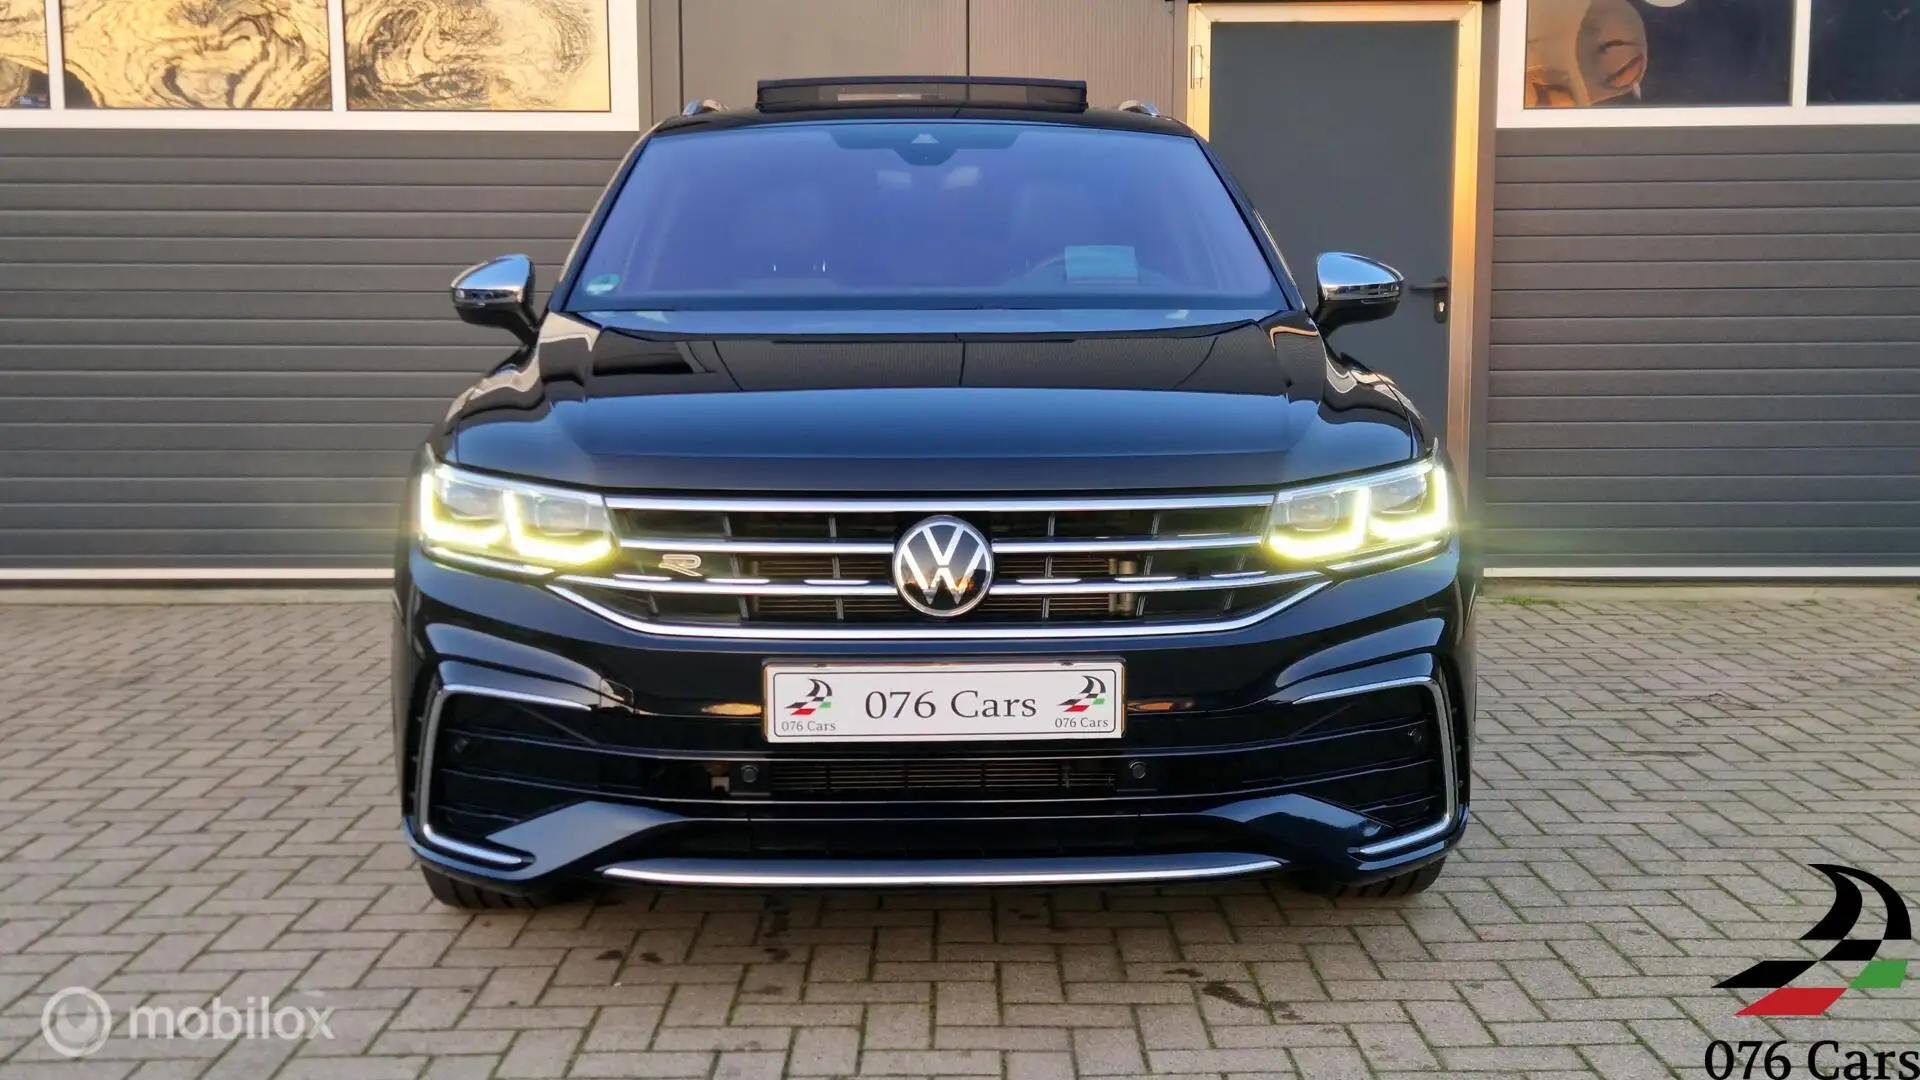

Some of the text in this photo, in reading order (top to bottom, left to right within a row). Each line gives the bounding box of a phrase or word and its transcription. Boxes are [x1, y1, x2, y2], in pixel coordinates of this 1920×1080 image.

[864, 689, 1038, 719] 076 Cars
[781, 720, 836, 731] 076 Cars
[1054, 716, 1109, 728] 076 Cars
